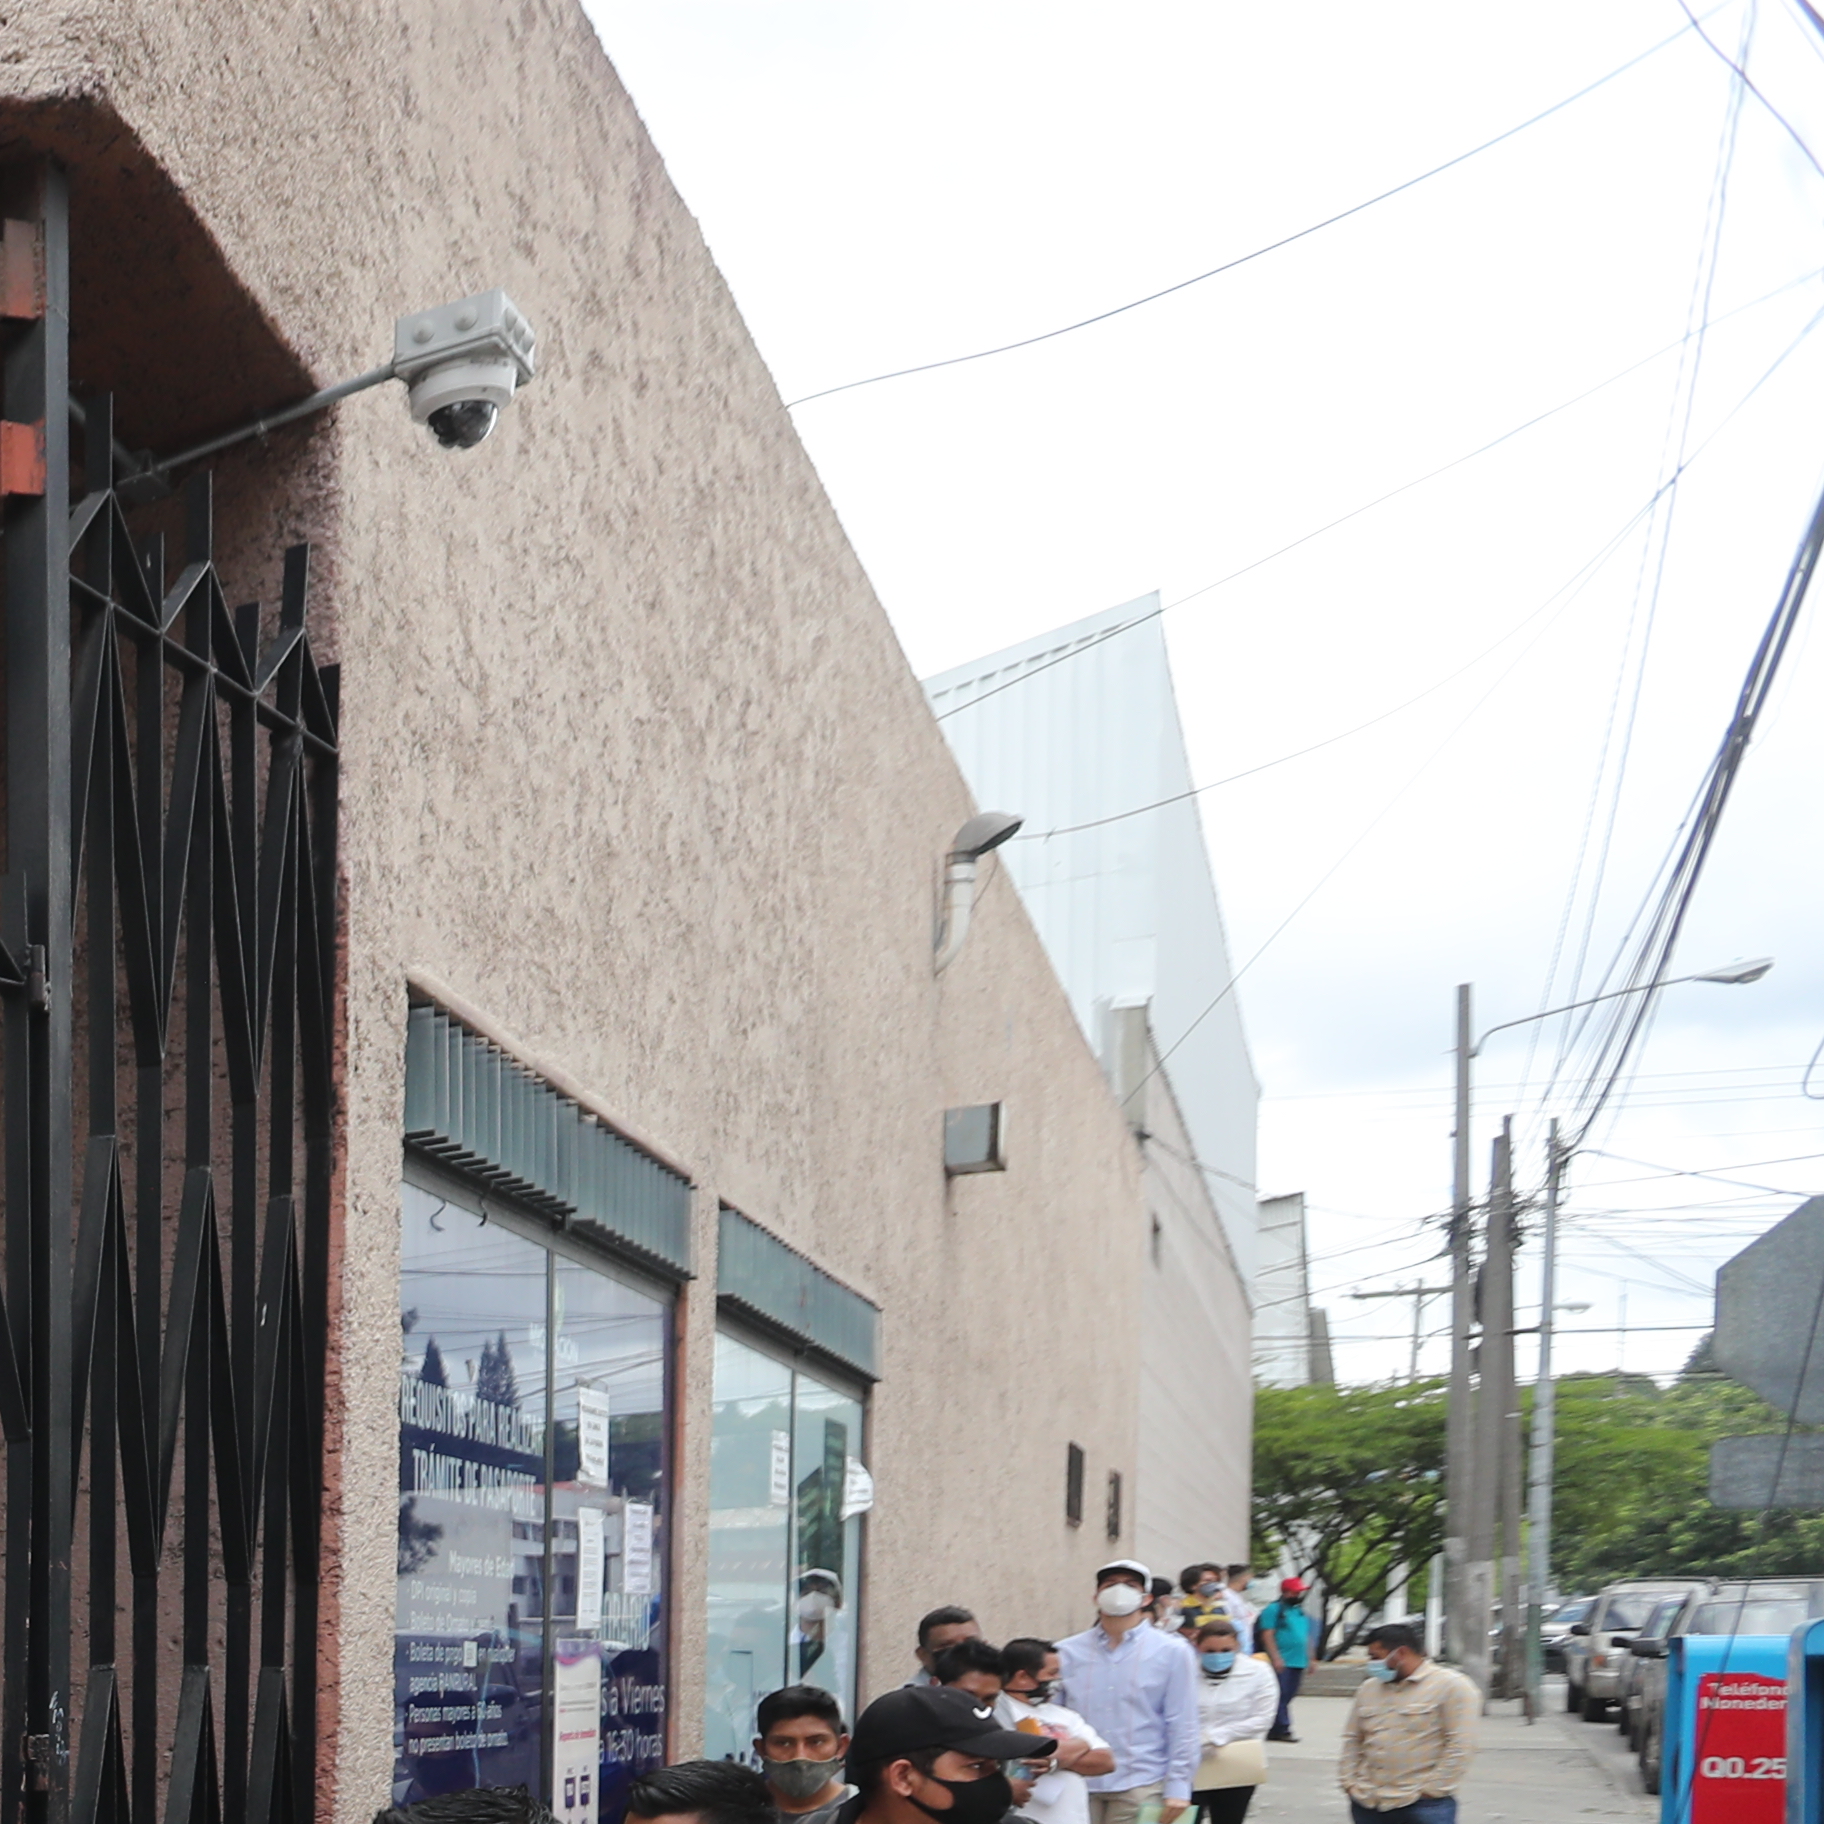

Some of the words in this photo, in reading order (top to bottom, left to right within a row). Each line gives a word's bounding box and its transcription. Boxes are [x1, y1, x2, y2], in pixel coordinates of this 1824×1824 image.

[401, 1374, 467, 1439] REQUISITOS
[467, 1394, 497, 1447] PARA
[412, 1443, 463, 1503] TRÁMITE
[464, 1459, 480, 1506] DE
[480, 1463, 537, 1517] PASAPORTE
[449, 1550, 483, 1578] Mayores
[621, 1676, 665, 1715] Viernes
[1699, 1696, 1788, 1710] Moneder
[409, 1704, 442, 1723] Personas
[635, 1727, 663, 1760] horas
[1700, 1756, 1787, 1779] Q0.25
